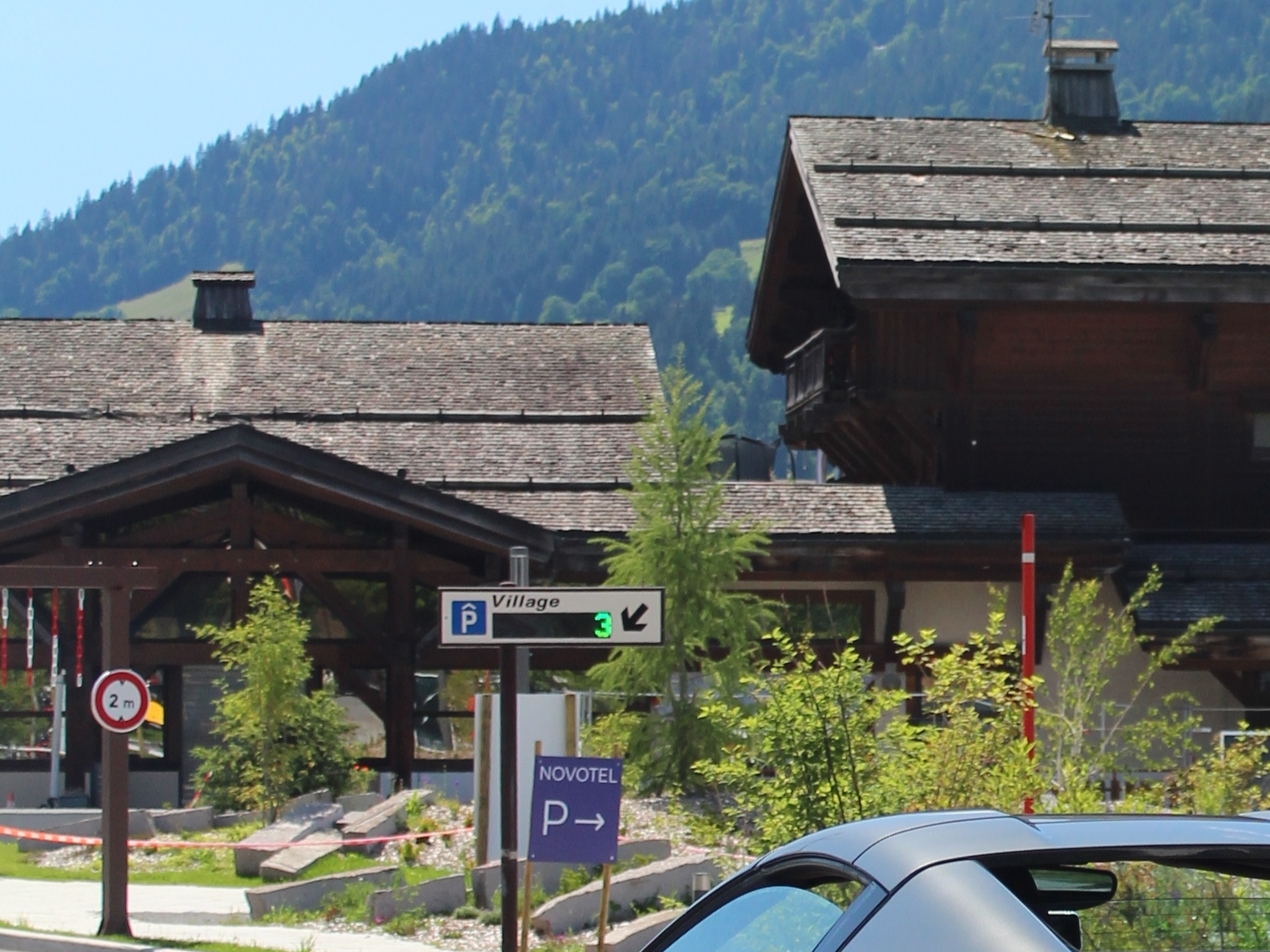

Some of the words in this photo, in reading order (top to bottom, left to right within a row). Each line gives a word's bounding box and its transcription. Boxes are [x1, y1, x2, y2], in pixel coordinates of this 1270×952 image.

[492, 594, 560, 611] Village
[593, 611, 613, 639] 3
[110, 694, 118, 708] 2
[124, 700, 134, 708] m
[539, 765, 618, 785] NOVOTEL
[542, 799, 569, 837] P
